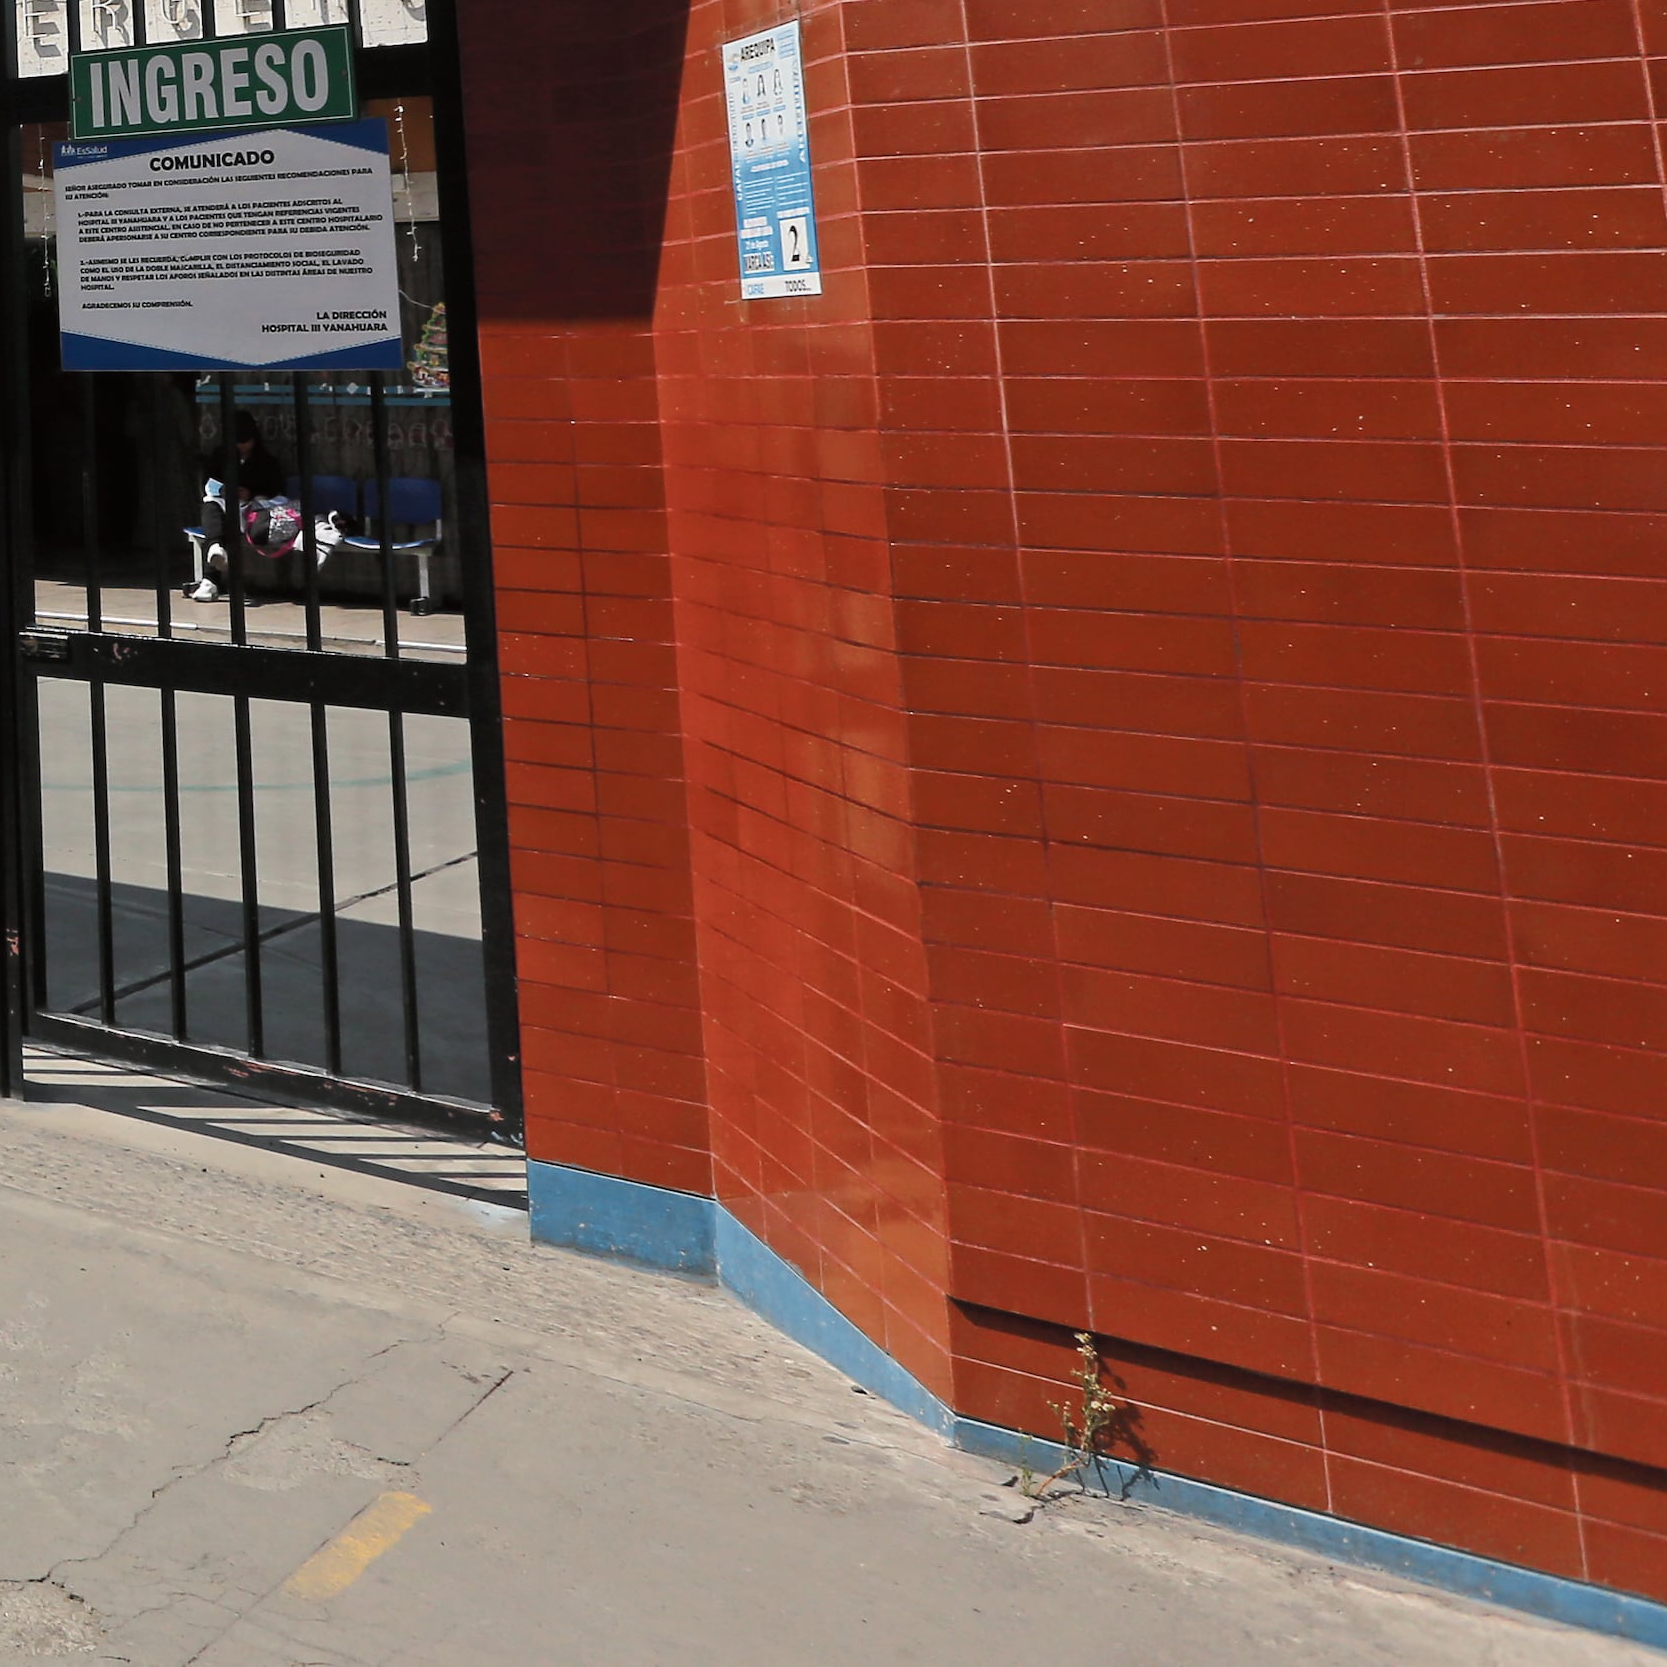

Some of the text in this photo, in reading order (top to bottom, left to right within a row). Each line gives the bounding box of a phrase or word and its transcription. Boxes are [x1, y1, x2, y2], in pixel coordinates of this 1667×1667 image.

[89, 39, 329, 128] INGRESO
[150, 150, 275, 171] COMUNICADO
[127, 180, 152, 188] TOMAR
[220, 175, 233, 183] LAS
[234, 173, 275, 182] SEGUIENTES
[276, 168, 350, 179] RECOMENDACIONES
[113, 208, 149, 216] CONSULTA
[251, 200, 291, 208] PACIENTES
[291, 198, 331, 206] ADSCRITOS
[77, 218, 110, 226] HOSPITAL
[118, 216, 161, 224] YANAHUARA
[188, 212, 226, 220] PACIENTES
[226, 211, 242, 219] QUE
[243, 210, 274, 218] TENGAN
[274, 207, 323, 216] REFERENCIAS
[324, 206, 360, 214] VIGENTES
[182, 222, 201, 230] CASO
[201, 221, 212, 229] DE
[224, 219, 271, 227] PERTENECER
[295, 216, 327, 224] CENTRO
[327, 214, 383, 223] HOSPITALARIO
[198, 228, 266, 237] CORRESPONDIENTE
[299, 225, 328, 233] DEBIDA
[211, 253, 228, 261] CON
[243, 251, 292, 260] PROTOCOLOS
[304, 249, 360, 257] BIOSEGURIDAD
[124, 265, 134, 273] DE
[145, 264, 169, 272] DOBLE
[225, 260, 291, 269] DISTANCIAMIENTO
[316, 309, 387, 320] LA DIRECCIÓN
[261, 322, 387, 332] HOSPITAL III YANAHUARA
